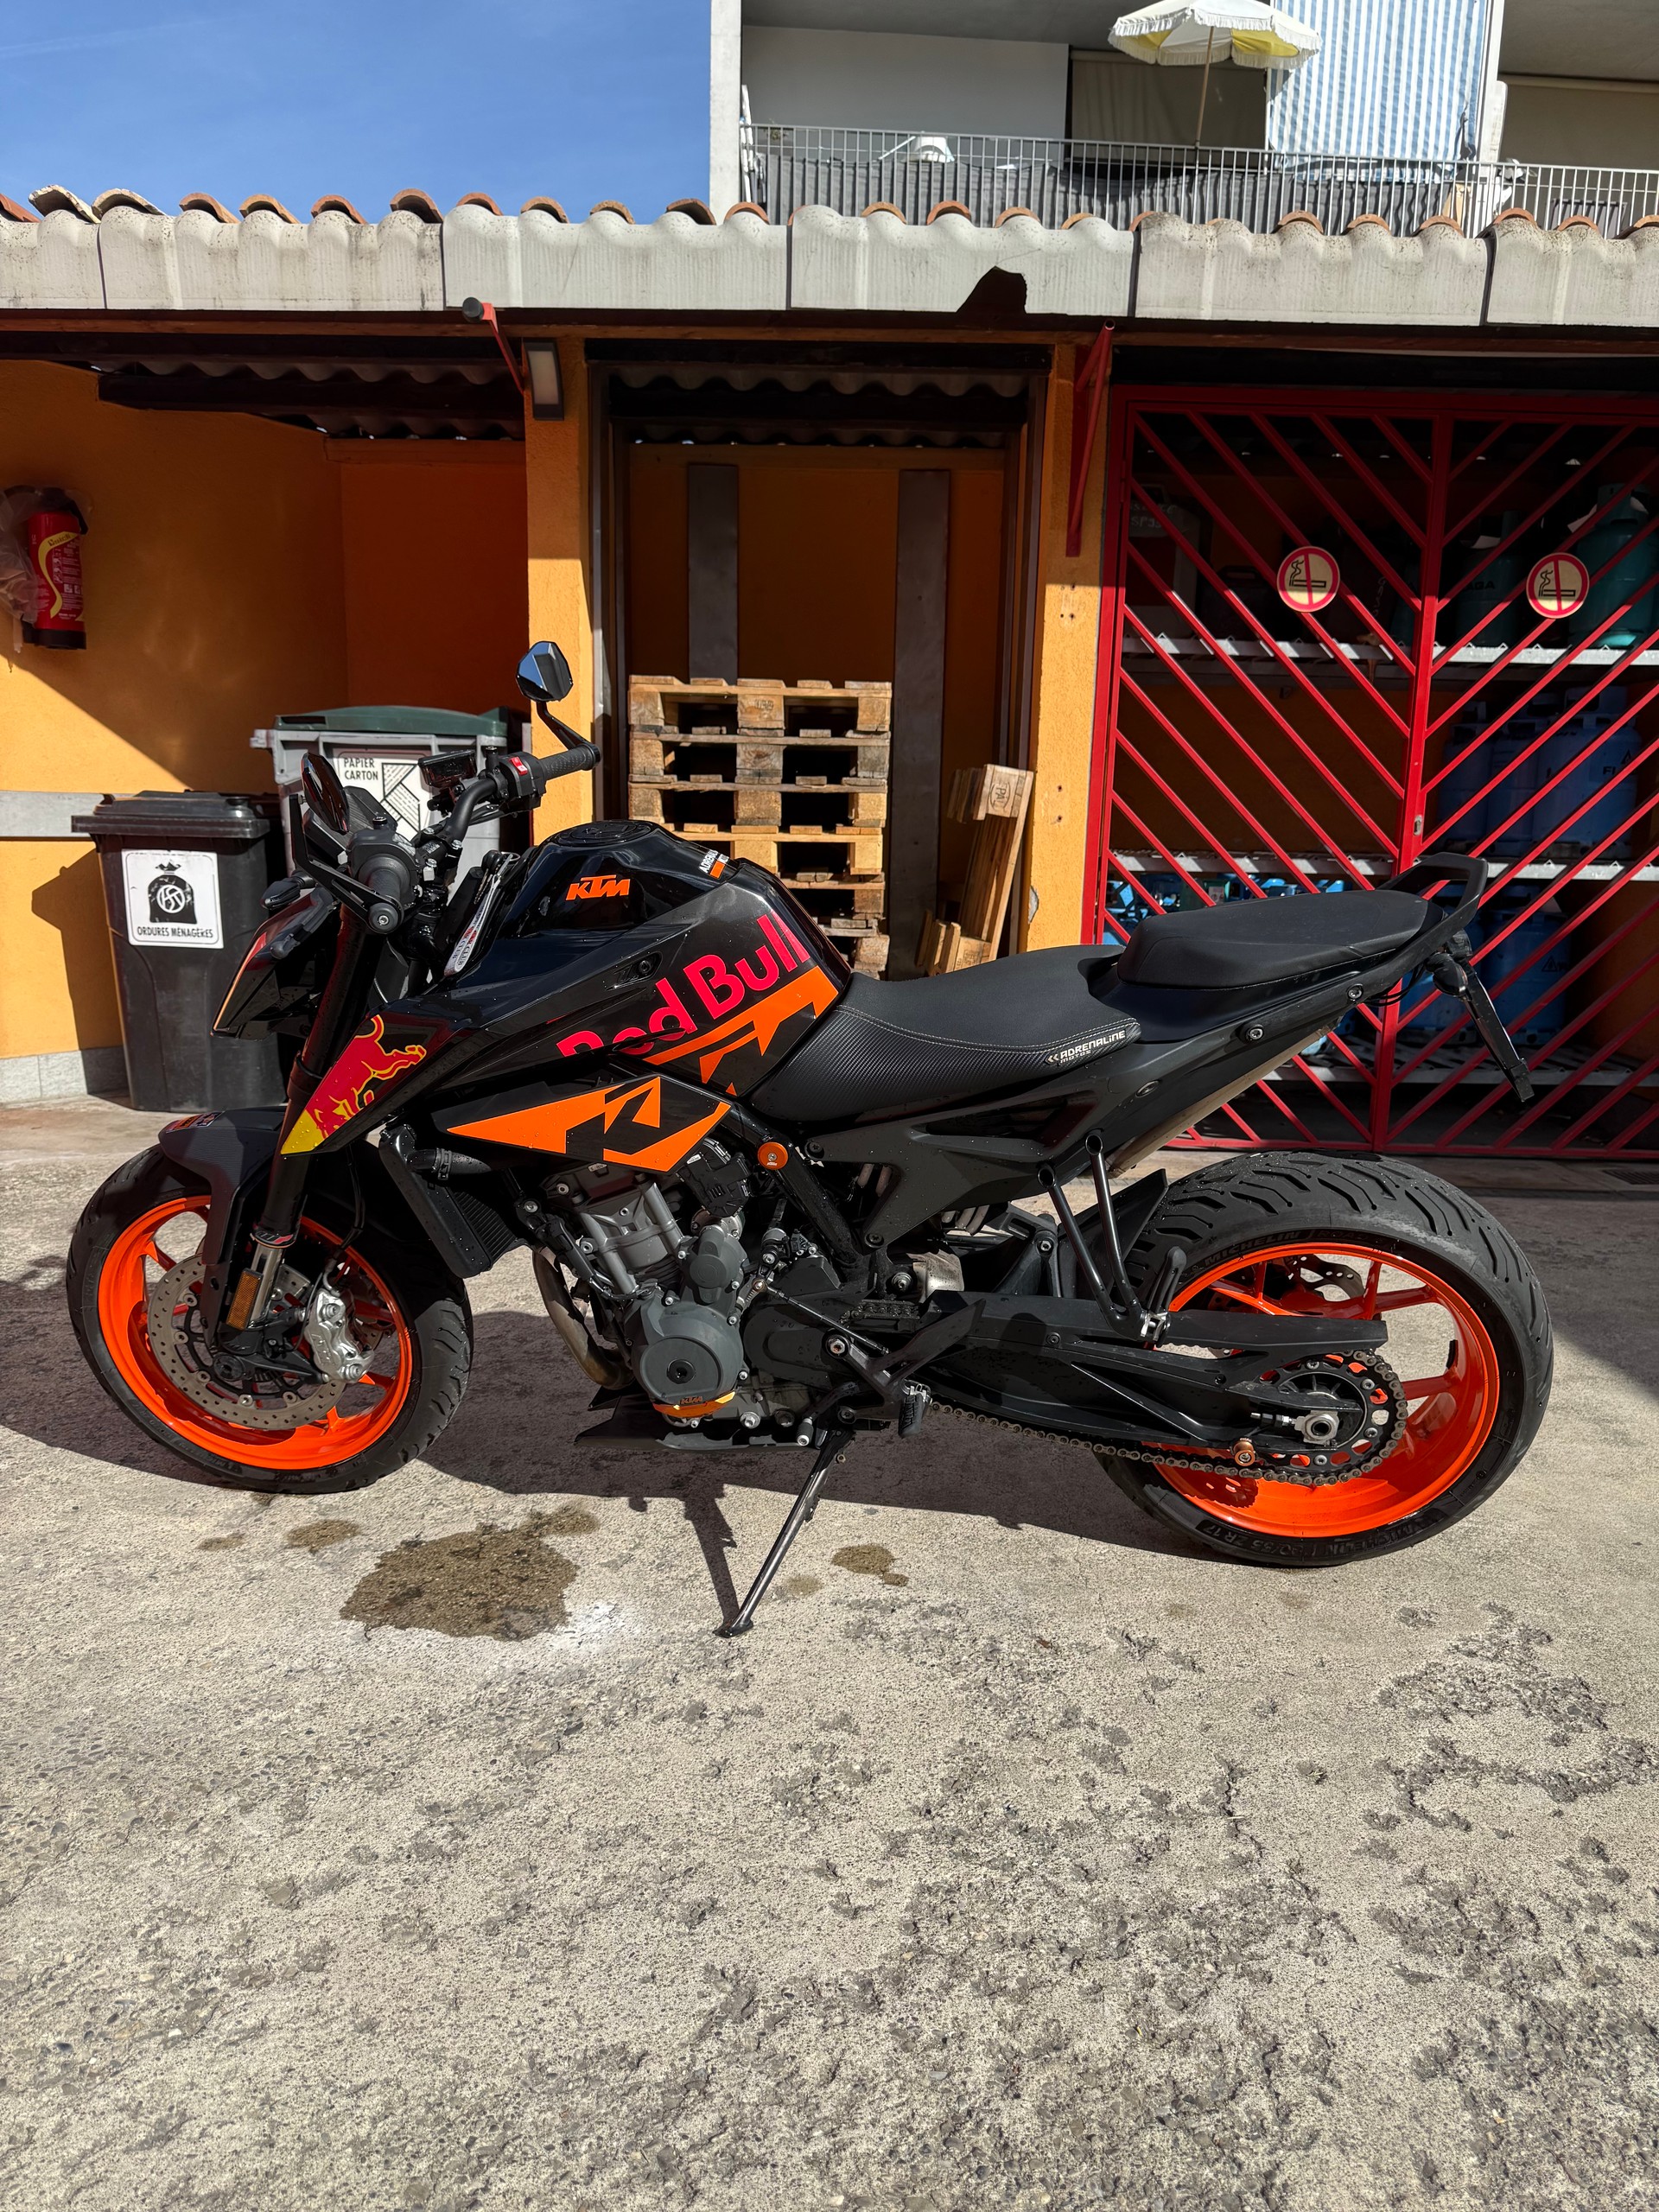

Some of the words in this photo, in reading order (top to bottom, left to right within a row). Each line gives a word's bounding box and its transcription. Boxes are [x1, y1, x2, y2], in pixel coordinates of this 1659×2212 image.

[343, 757, 375, 768] PAPIER
[344, 770, 378, 780] CARTON
[566, 874, 631, 901] KTM
[137, 925, 170, 937] ORDURES
[683, 910, 810, 1020] Bull
[1204, 1230, 1301, 1268] MICHELIN
